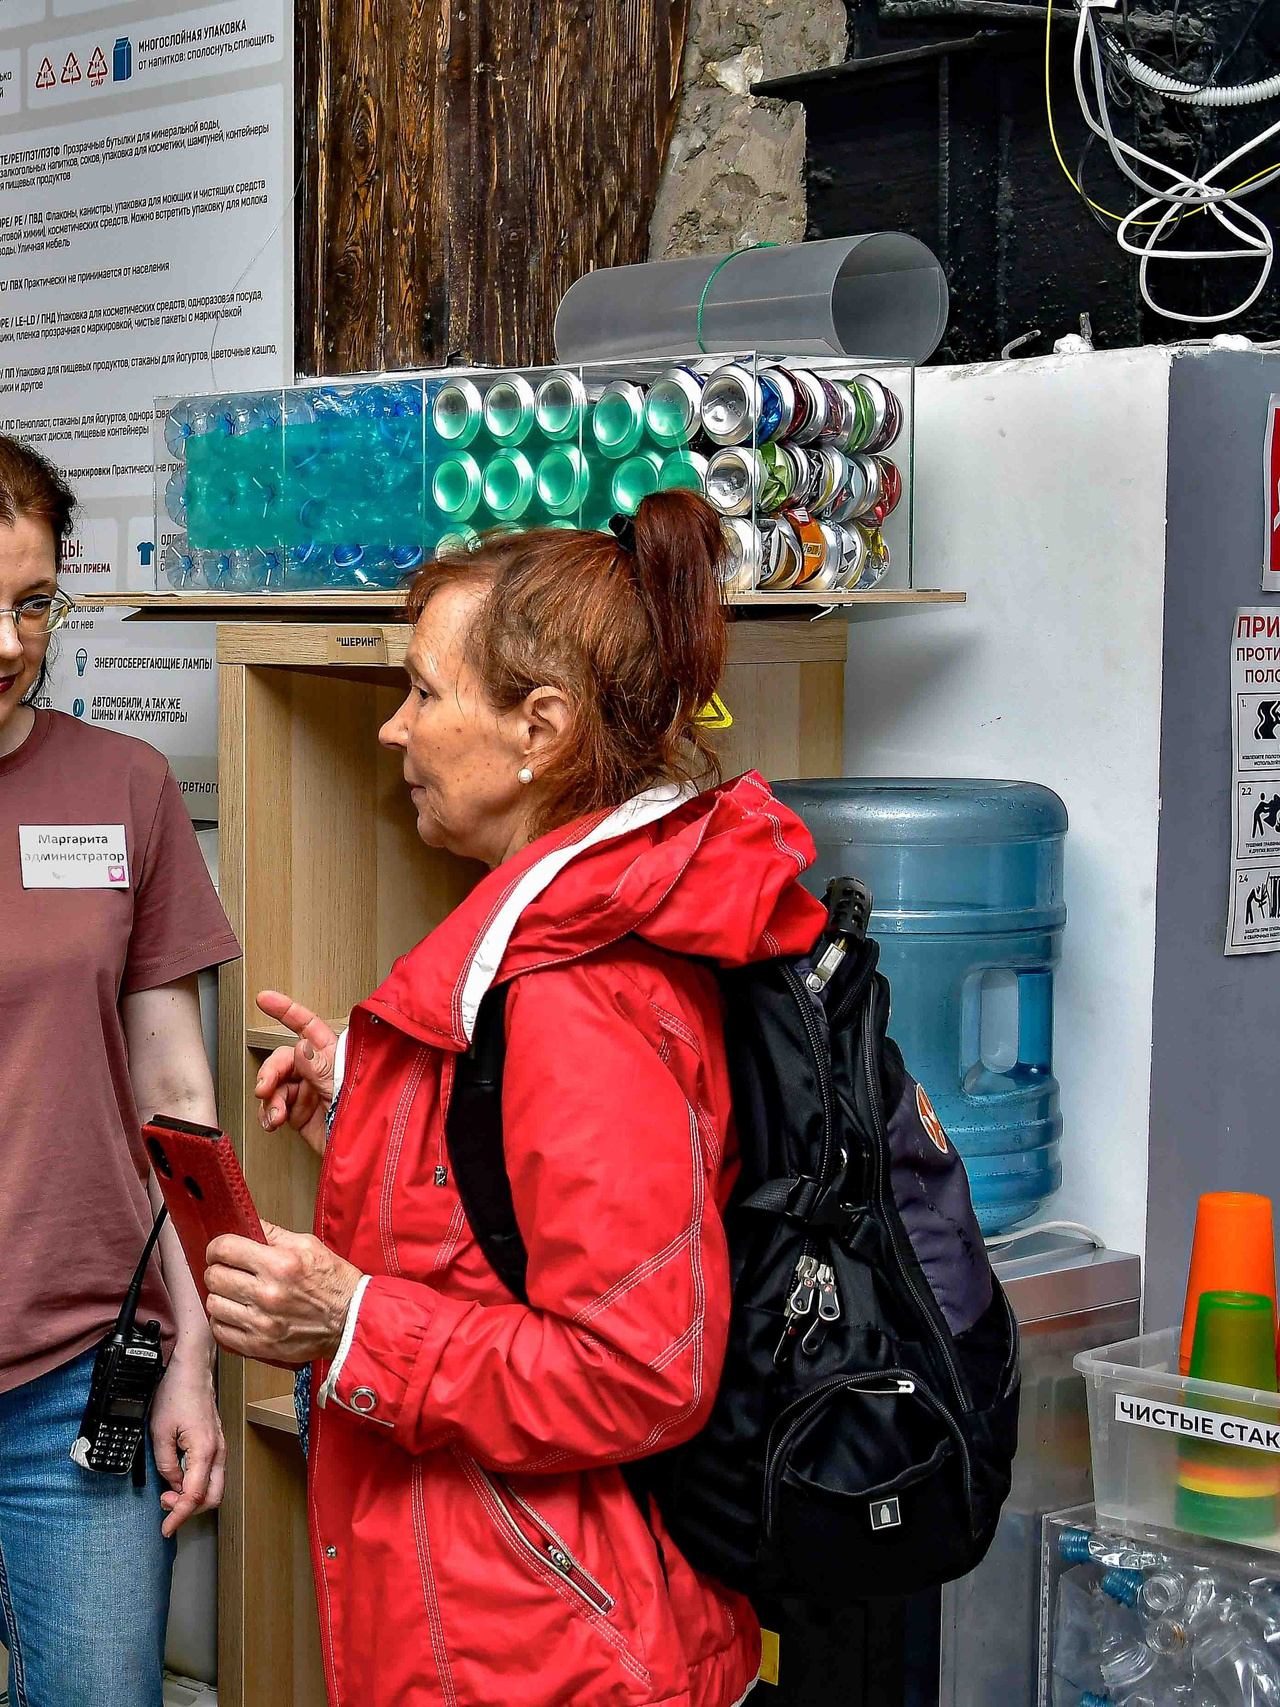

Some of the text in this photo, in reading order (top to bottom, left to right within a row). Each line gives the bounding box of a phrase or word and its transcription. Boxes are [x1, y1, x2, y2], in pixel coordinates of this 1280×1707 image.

[138, 19, 247, 53] МНОГОСЛОЙНАЯ УПАКОВКА
[138, 59, 147, 70] от
[148, 52, 186, 69] напитков:
[63, 138, 105, 156] Прозрачные
[106, 133, 136, 150] бутылки
[137, 131, 150, 143] для
[151, 122, 198, 140] минеральной
[199, 119, 220, 131] воды,
[47, 157, 79, 171] напитков,
[80, 152, 101, 166] соков,
[102, 146, 133, 163] упаковка
[133, 144, 147, 157] для
[148, 138, 186, 154] косметики,
[187, 131, 224, 147] шампуней,
[225, 124, 269, 140] контейнеры
[5, 178, 35, 191] пищевых
[36, 172, 71, 187] продуктов
[14, 216, 23, 227] PE
[29, 212, 43, 225] ПВД
[45, 209, 78, 222] Флаконы,
[114, 198, 147, 213] упаковка
[148, 195, 162, 206] для
[162, 191, 192, 204] моющих
[193, 189, 198, 198] и
[199, 183, 235, 197] чистящих
[235, 179, 266, 193] средств
[47, 220, 98, 236] косметических
[130, 210, 155, 225] Можно
[155, 206, 191, 221] встретить
[191, 202, 224, 218] упаковку
[225, 200, 239, 210] для
[240, 194, 268, 207] молока
[17, 241, 45, 254] Уличная
[45, 238, 70, 250] мебель
[9, 279, 23, 291] ПВХ
[24, 276, 67, 290] Практически
[68, 274, 76, 283] не
[77, 267, 122, 285] принимается
[123, 267, 131, 277] от
[132, 261, 170, 276] населения
[15, 315, 36, 327] LE-LD
[41, 313, 56, 326] ПНД
[57, 311, 88, 323] Упаковка
[88, 309, 102, 319] для
[103, 302, 156, 317] косметических
[156, 299, 186, 313] средств,
[187, 293, 235, 310] одноразовая
[235, 289, 263, 303] посуда,
[16, 330, 40, 342] пленка
[40, 327, 81, 340] прозрачная
[134, 316, 160, 329] чистые
[161, 313, 188, 325] пакеты
[15, 365, 46, 379] Упаковка
[46, 365, 59, 375] для
[60, 362, 92, 375] пищевых
[92, 358, 130, 373] продуктов,
[130, 355, 160, 367] стаканы
[161, 355, 175, 366] для
[175, 349, 209, 363] йогуртов,
[210, 347, 251, 361] цветочные
[251, 343, 277, 356] кашпо,
[19, 380, 44, 393] другое
[52, 416, 81, 427] стаканы
[81, 415, 95, 427] для
[20, 424, 150, 443] компакт дисков, пищевые контейнеры
[68, 466, 111, 479] маркировки
[83, 562, 111, 574] ПРИЕМА
[71, 621, 94, 630] от нее
[1237, 616, 1280, 638] ПРИ
[1236, 647, 1280, 661] ПРОТИ
[94, 657, 213, 671] ЭНЕРГОСБЕРЕГАЮЩИЕ ЛАМПЫ
[1245, 669, 1280, 683] ПОЛО
[91, 696, 181, 710] АВТОМОБИЛИ, А ТАК ЖЕ
[91, 709, 188, 723] ШИНЫ И АККУМУЛЯТОРЫ
[38, 834, 108, 846] Маргарита
[24, 852, 125, 863] администратор
[1120, 1401, 1280, 1448] ЧИСТЫЕ СТАК
